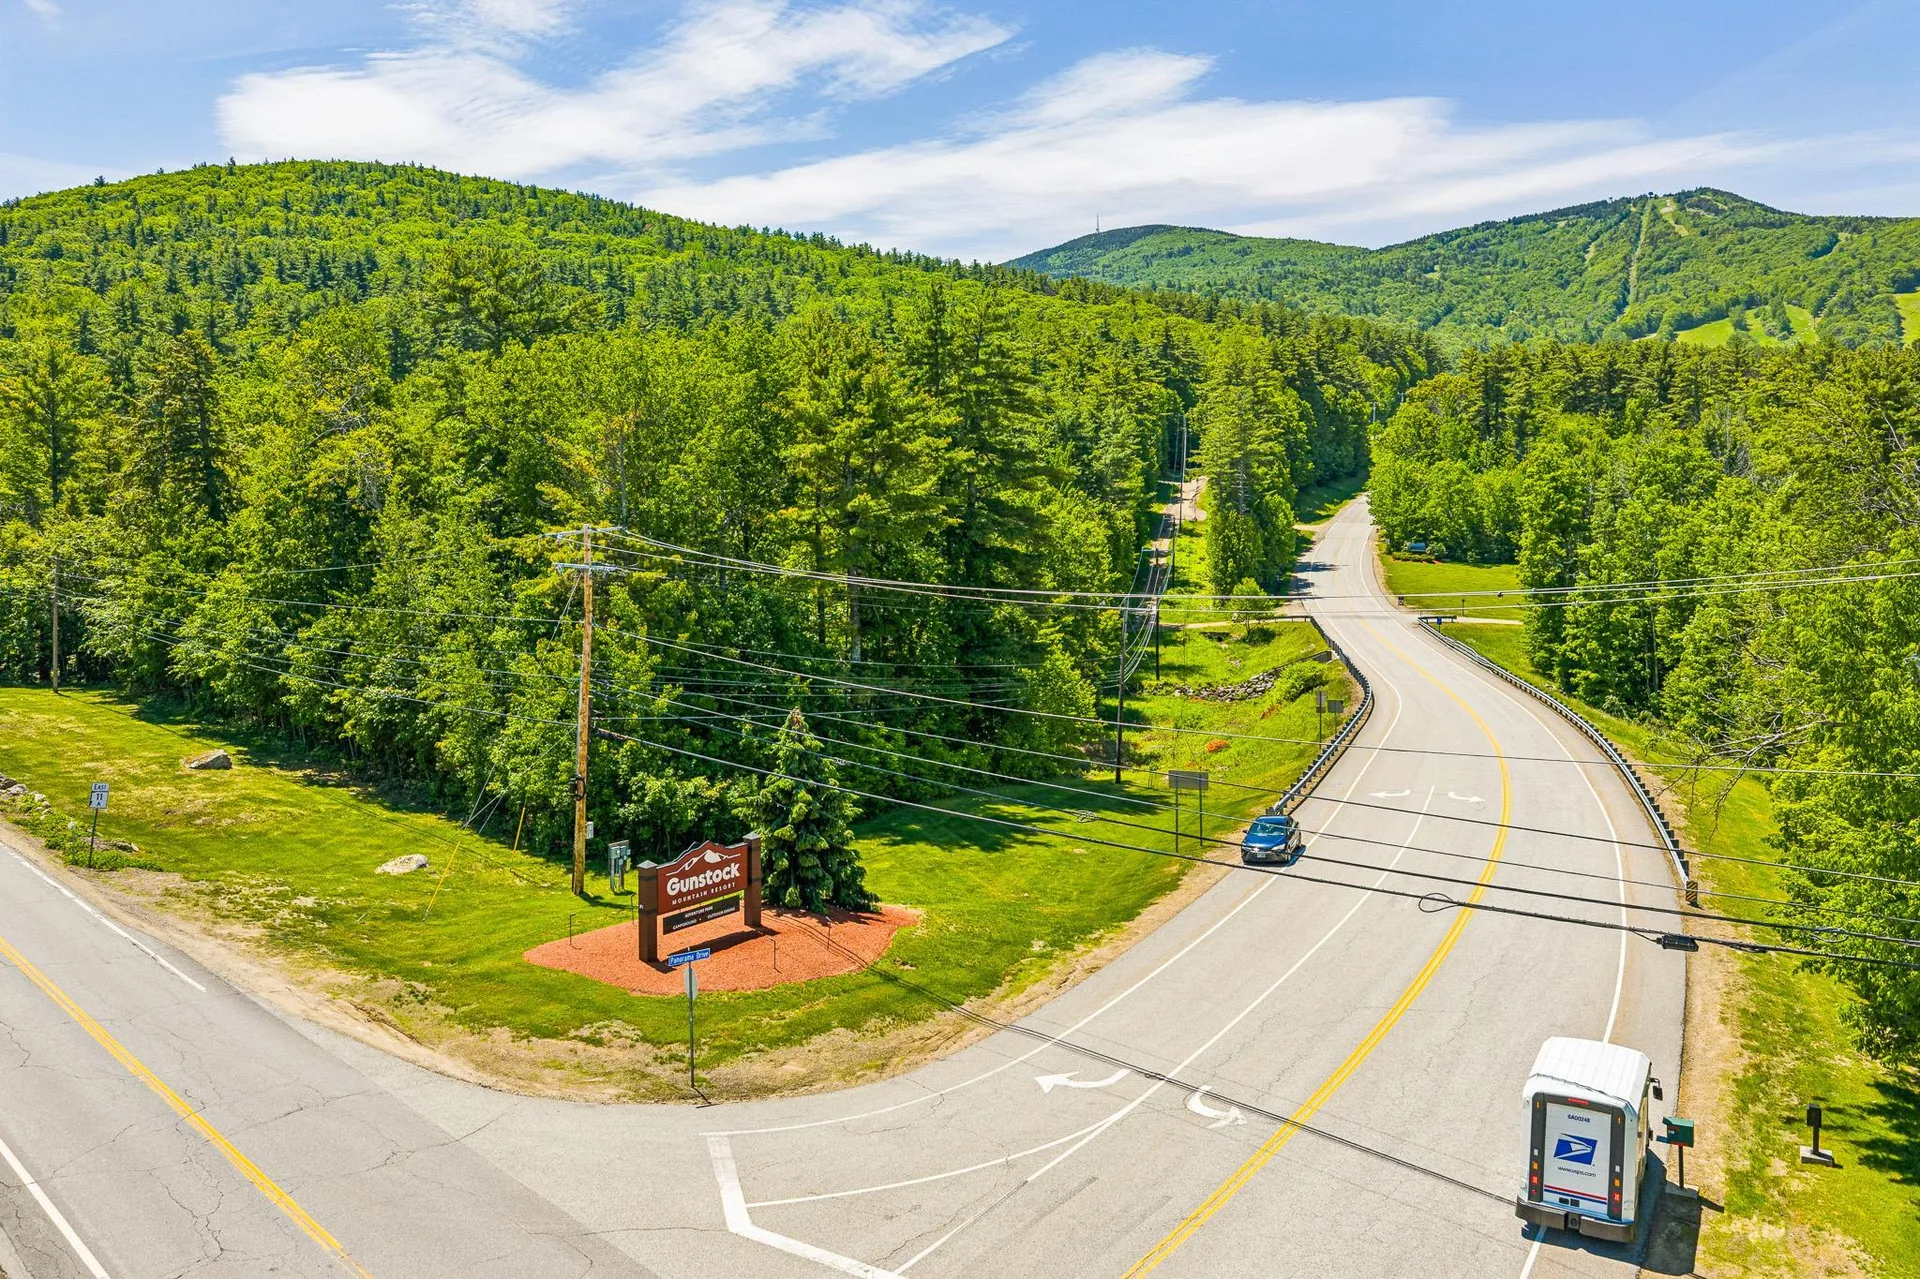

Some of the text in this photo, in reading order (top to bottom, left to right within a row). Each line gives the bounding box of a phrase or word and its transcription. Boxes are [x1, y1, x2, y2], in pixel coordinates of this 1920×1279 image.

[666, 862, 740, 896] Gunstock
[672, 882, 736, 904] MOUNTAIN RESORT
[672, 918, 698, 930] CAMPGROUND
[670, 952, 709, 964] Panorama Drive
[1558, 1166, 1596, 1178] www.usps.com
